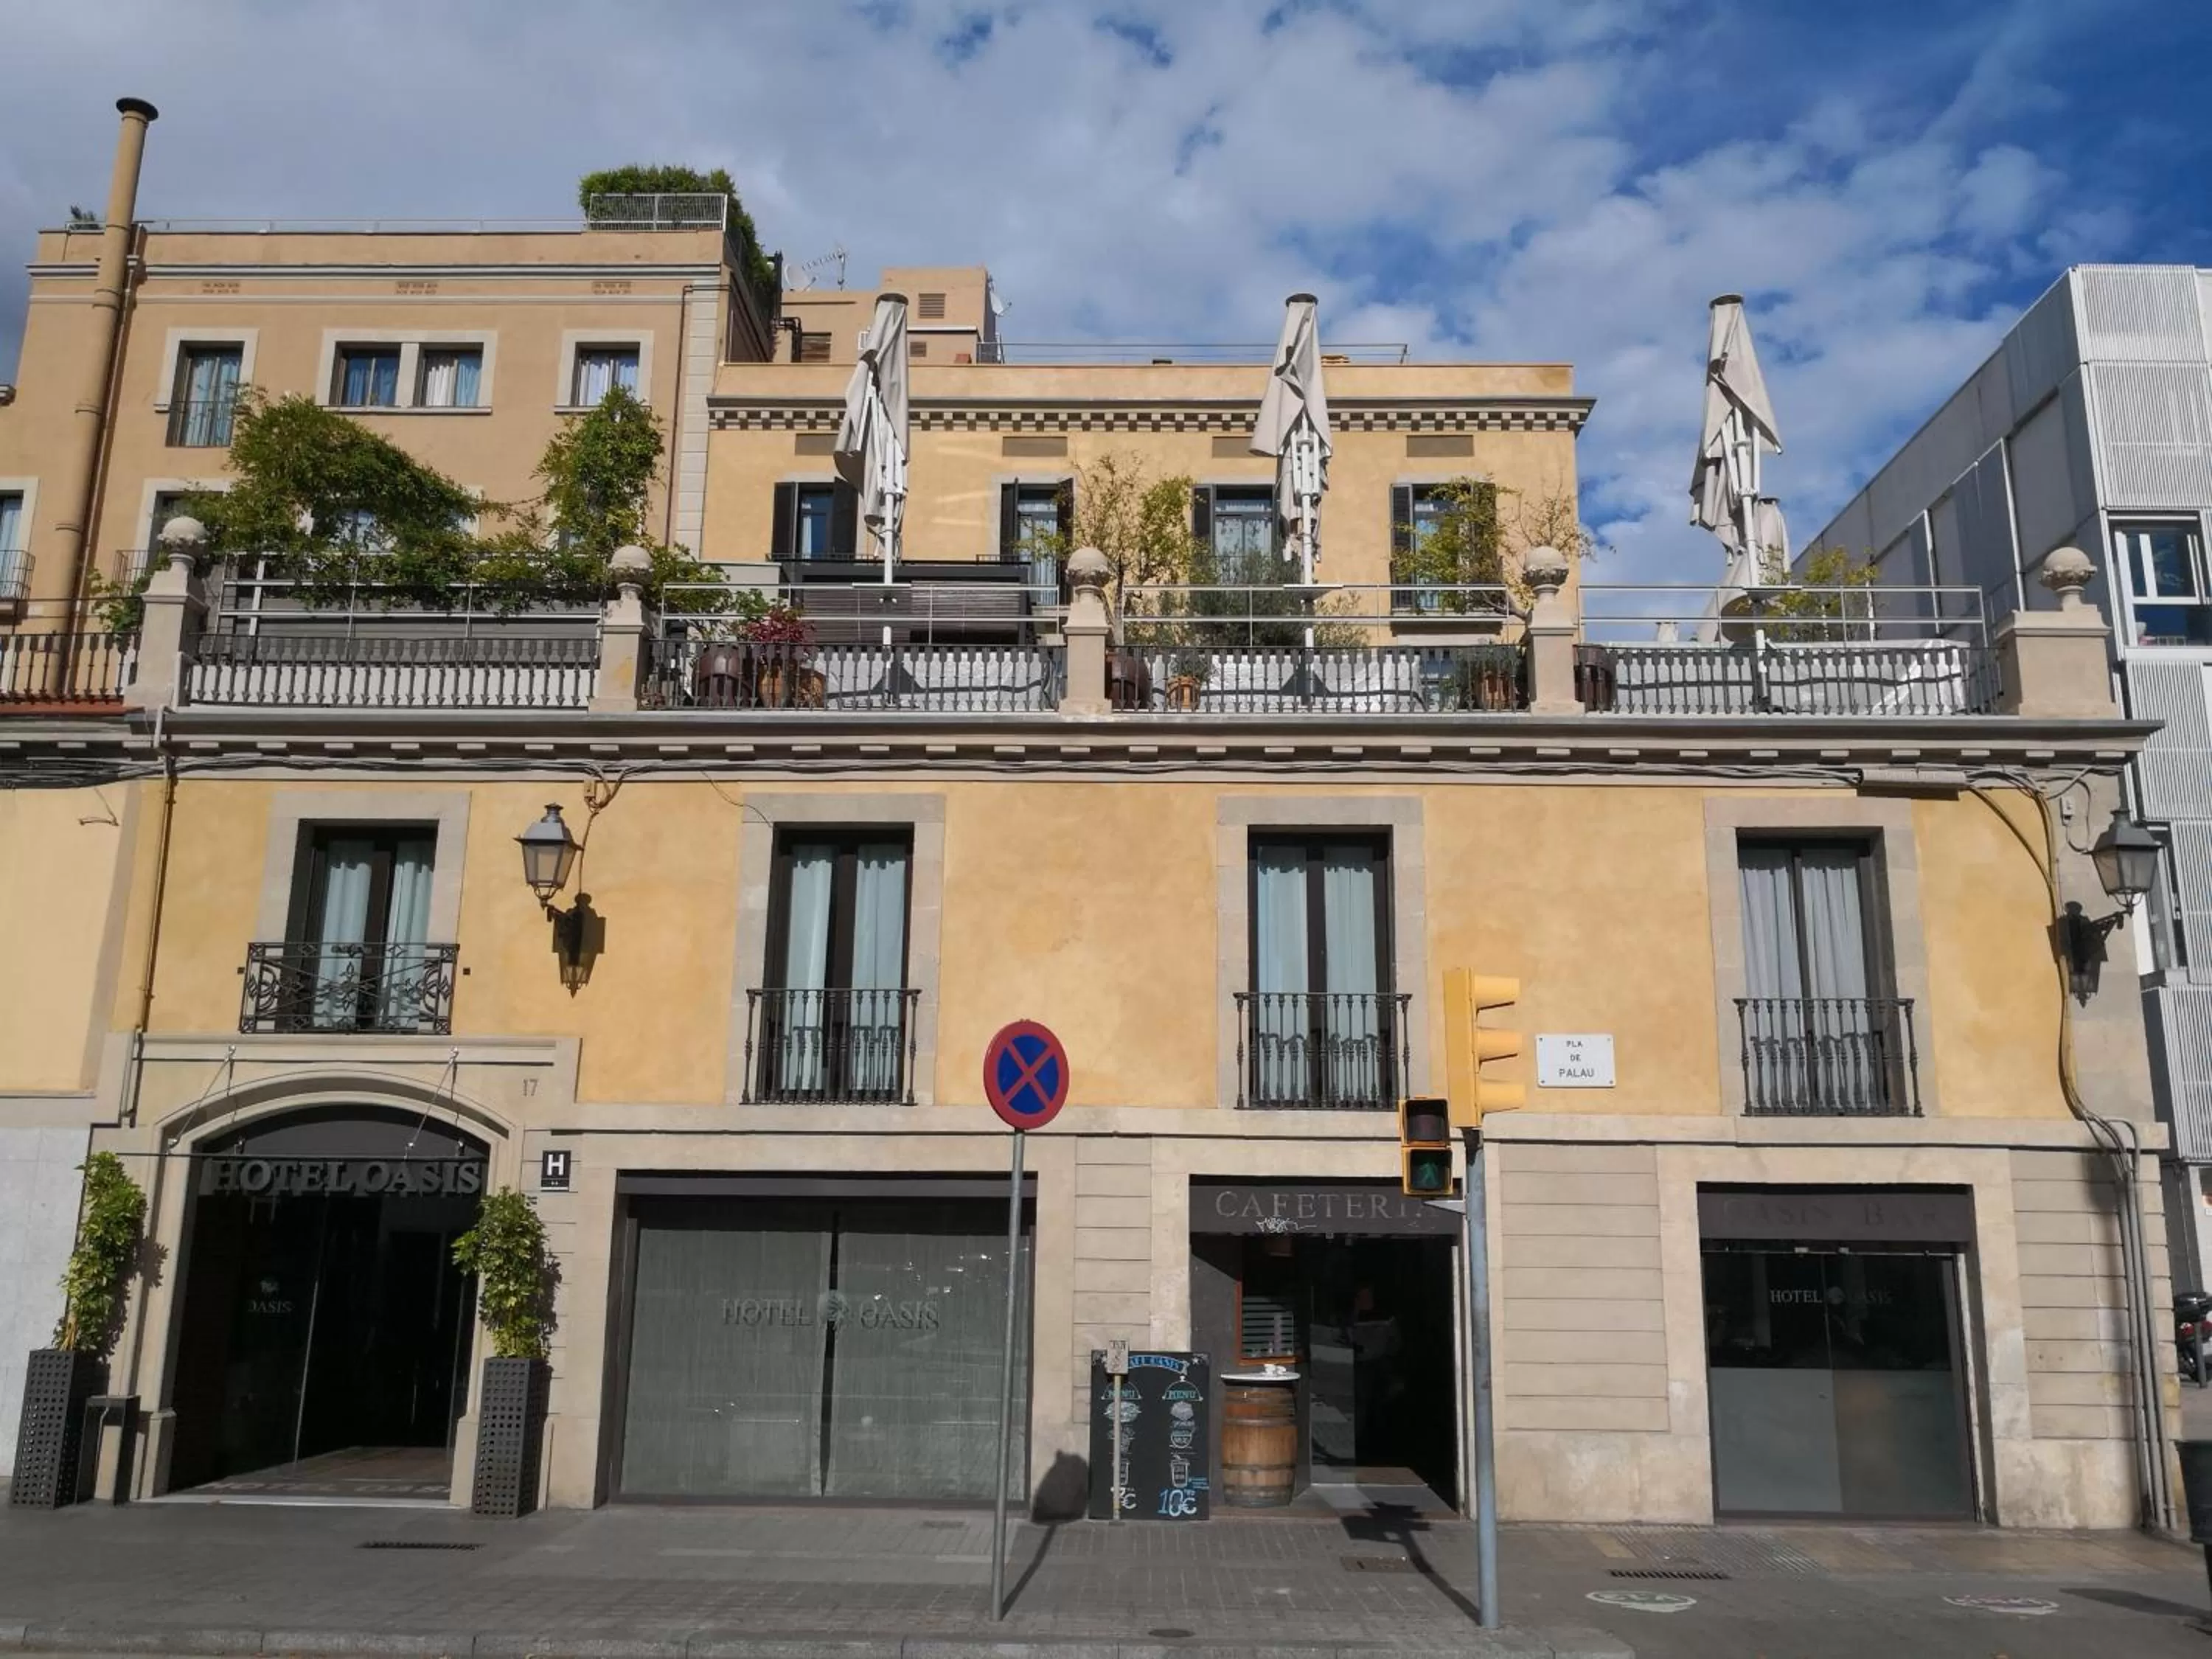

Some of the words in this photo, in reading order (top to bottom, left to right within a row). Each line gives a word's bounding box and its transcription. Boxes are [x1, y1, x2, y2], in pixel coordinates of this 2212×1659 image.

[1569, 1054, 1582, 1062] DE
[1558, 1068, 1595, 1078] PALAU
[522, 1079, 538, 1097] 17
[546, 1153, 565, 1176] H
[214, 1160, 358, 1193] HOTEL
[363, 1161, 484, 1195] OASIS
[1770, 1289, 1823, 1304] HOTEL
[721, 1298, 814, 1326] HOTEL
[858, 1298, 940, 1329] OASIS
